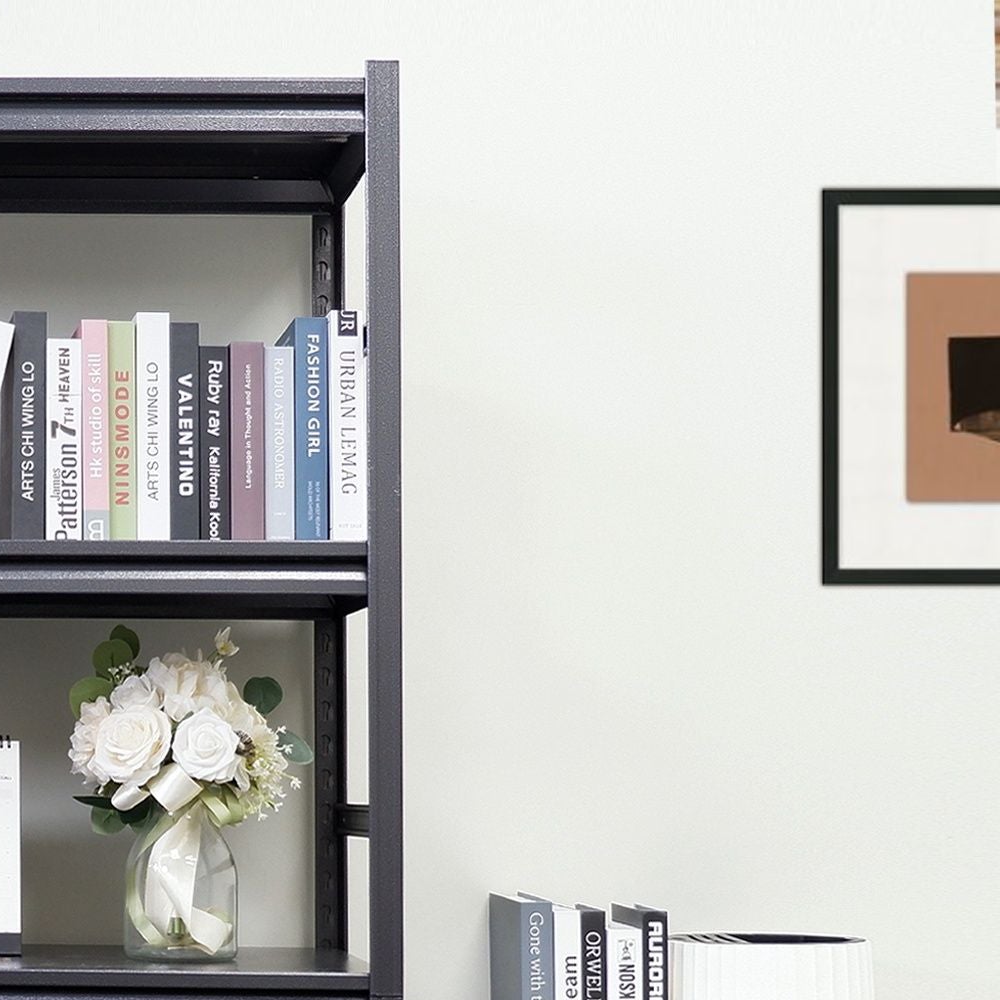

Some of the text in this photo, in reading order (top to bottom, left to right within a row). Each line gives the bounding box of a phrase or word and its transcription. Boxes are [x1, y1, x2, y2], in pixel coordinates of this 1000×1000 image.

[21, 361, 34, 501] ARTS CHI WING LO
[58, 347, 70, 403] HEAVEN
[88, 353, 102, 478] Hk studio of skill
[146, 361, 159, 501] ARTS CHI WING LO
[178, 373, 194, 497] VALENTINO
[207, 360, 223, 437] Ruby ray
[273, 358, 285, 489] RADIO ASTRONOMER
[307, 334, 320, 457] FASHION GIRL
[340, 351, 357, 494] URBAN LEMAG
[50, 468, 61, 501] James
[55, 444, 77, 540] Patterson
[115, 370, 129, 505] NINSMODE
[209, 446, 221, 509] Kalifornia
[529, 912, 544, 955] Gone
[530, 958, 545, 991] with
